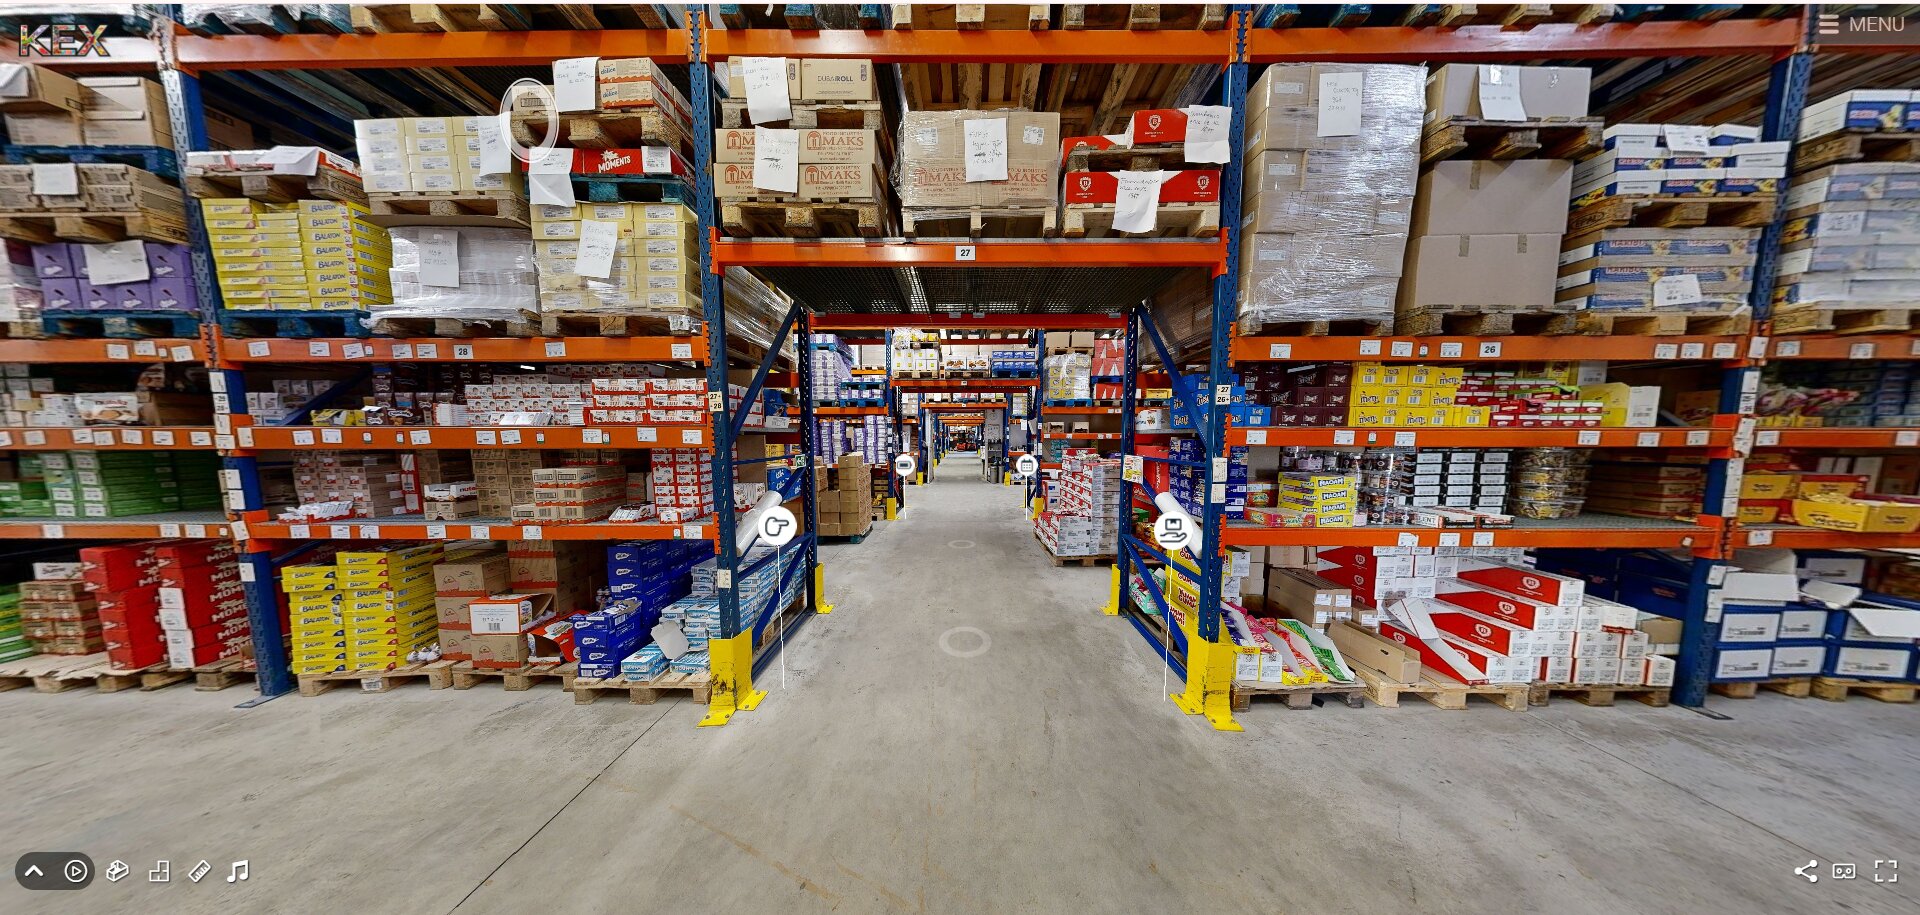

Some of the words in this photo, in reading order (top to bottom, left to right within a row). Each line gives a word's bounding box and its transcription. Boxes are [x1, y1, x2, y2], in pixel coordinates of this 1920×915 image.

[822, 137, 863, 146] MAKS
[598, 155, 631, 172] MOMENTS
[820, 171, 860, 179] MAKS
[1008, 173, 1048, 182] MAKS
[312, 218, 338, 226] BALATON
[319, 274, 345, 282] BALATON
[321, 287, 347, 295] BALATON
[458, 348, 467, 356] 28
[1319, 477, 1344, 487] MAOAM
[1322, 490, 1347, 500] MAOAM
[1322, 503, 1346, 512] MAOAM
[1320, 516, 1343, 524] MAOAM
